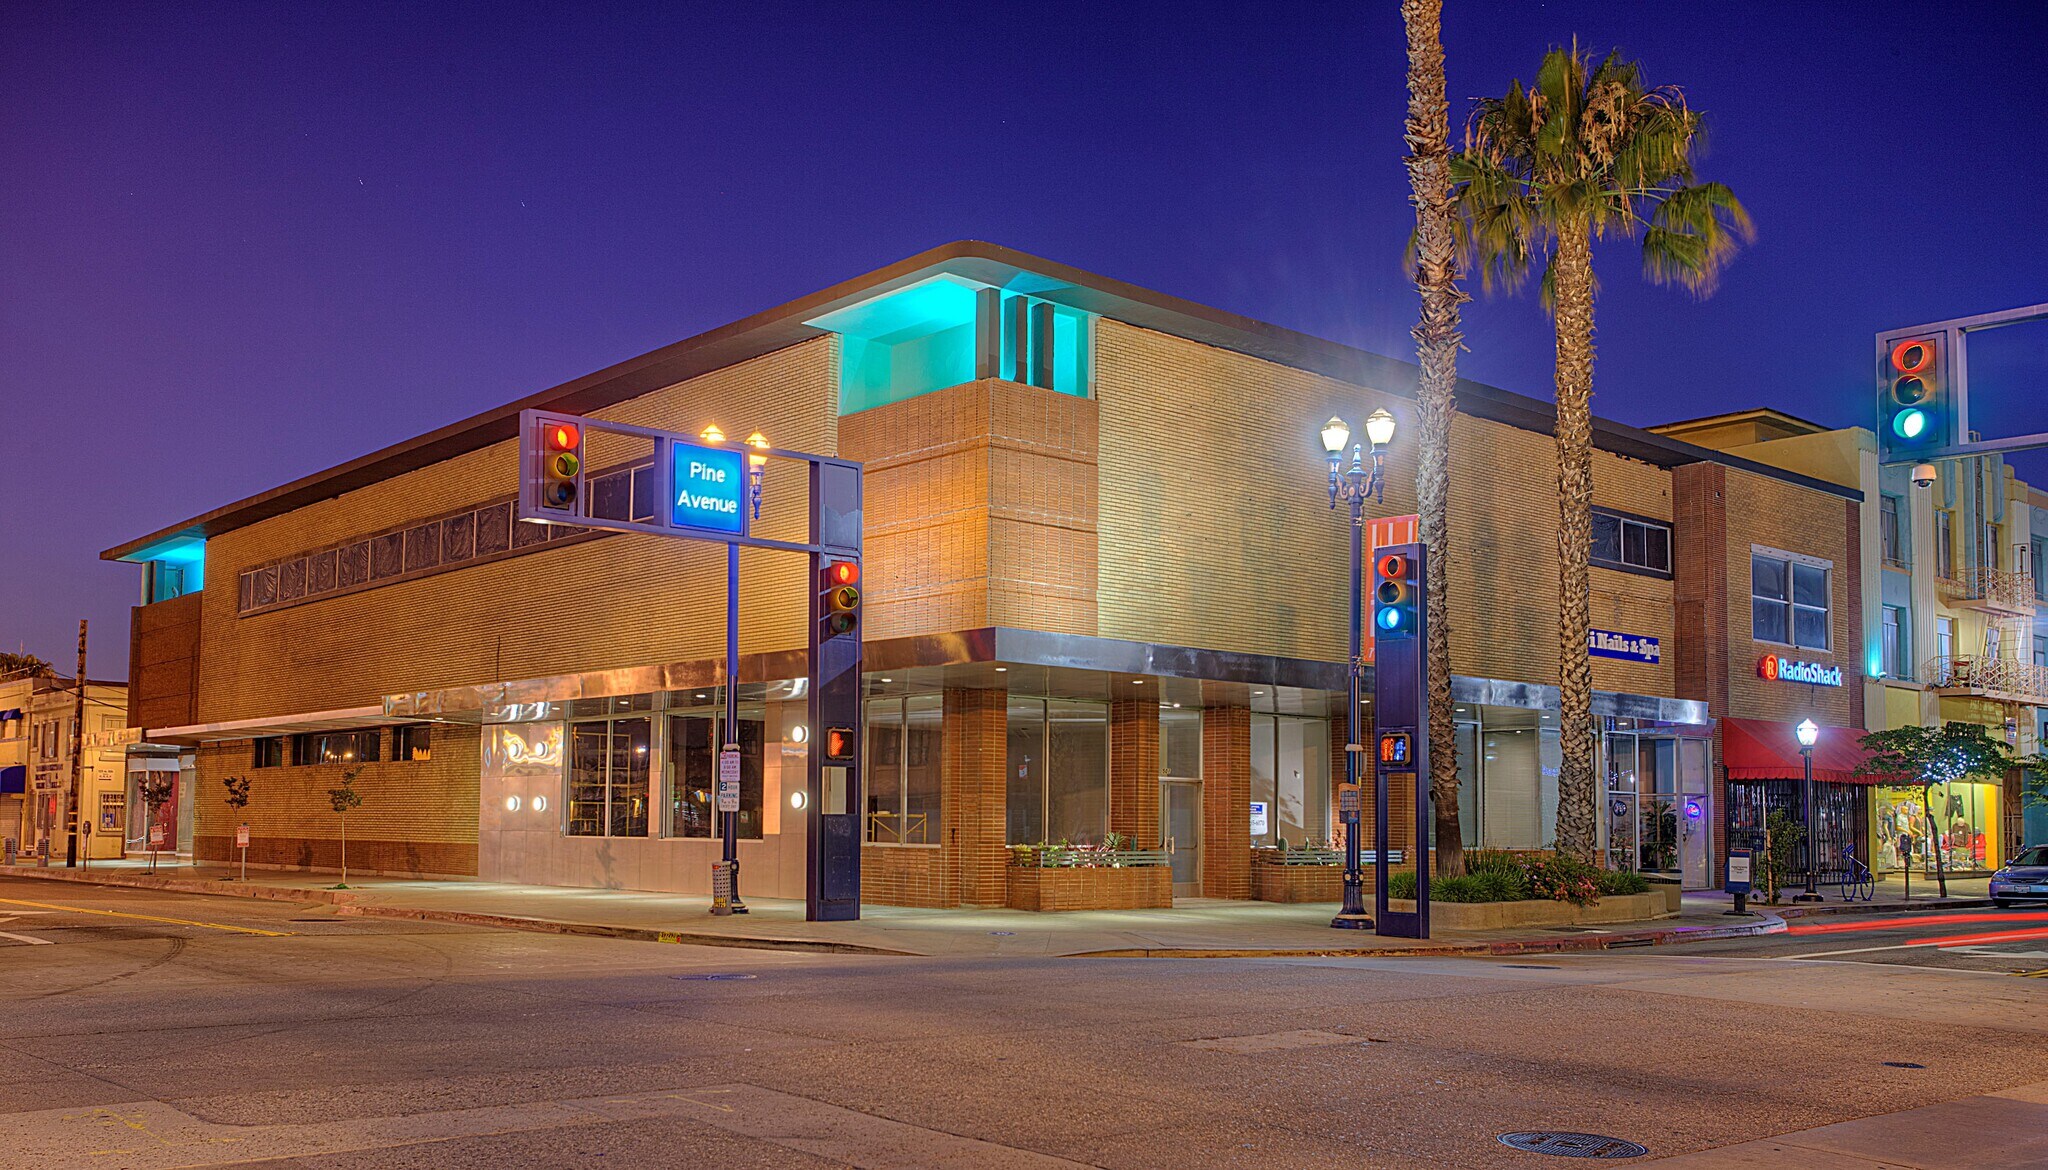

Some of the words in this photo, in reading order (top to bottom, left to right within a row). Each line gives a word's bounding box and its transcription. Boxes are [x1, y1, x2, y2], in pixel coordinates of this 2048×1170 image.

[690, 461, 726, 483] Pine
[677, 489, 738, 514] Avenue
[1596, 633, 1629, 652] Nails
[1630, 640, 1639, 653] &
[1639, 638, 1661, 660] Spa
[1778, 658, 1843, 687] RadioShack
[721, 782, 727, 790] 2
